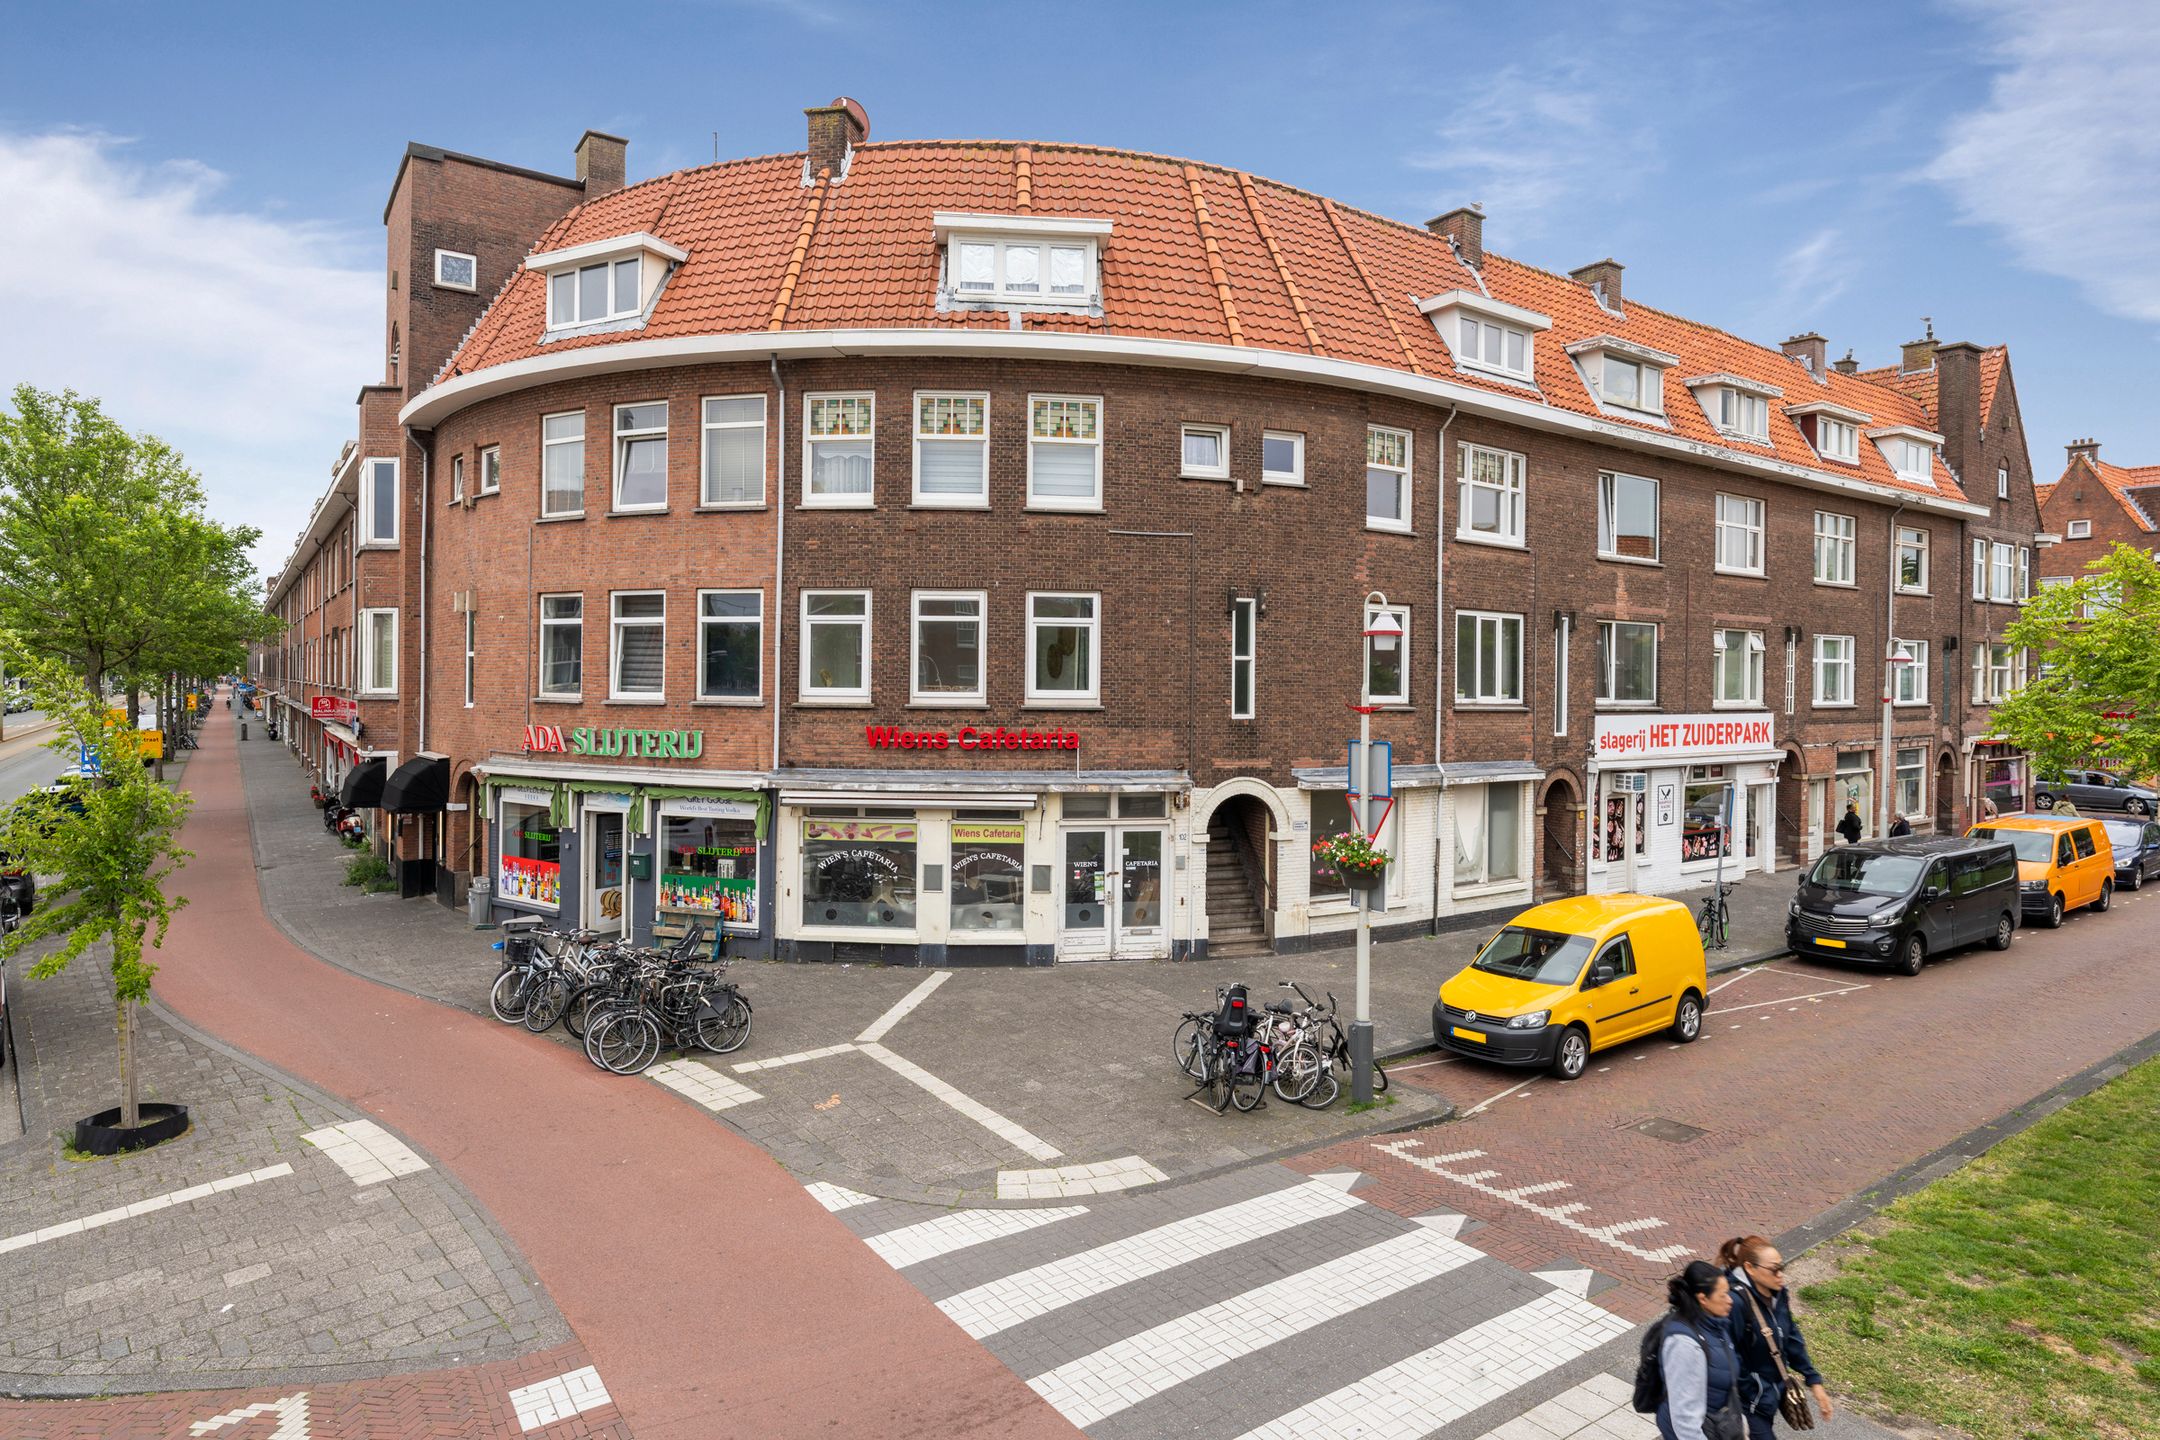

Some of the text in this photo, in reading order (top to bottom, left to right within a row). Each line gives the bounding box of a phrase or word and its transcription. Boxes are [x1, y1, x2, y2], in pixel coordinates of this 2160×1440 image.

[521, 725, 703, 759] ADA SLIJTERIJ
[866, 726, 1079, 750] Wiens Cafetaria
[1600, 722, 1770, 753] slagerij HET ZUIDERPARK
[954, 829, 1021, 838] Wiens Cafetaria
[818, 849, 899, 873] WIEN'S CAFETARIA
[953, 852, 1023, 872] WIEN'S CAFETARIA
